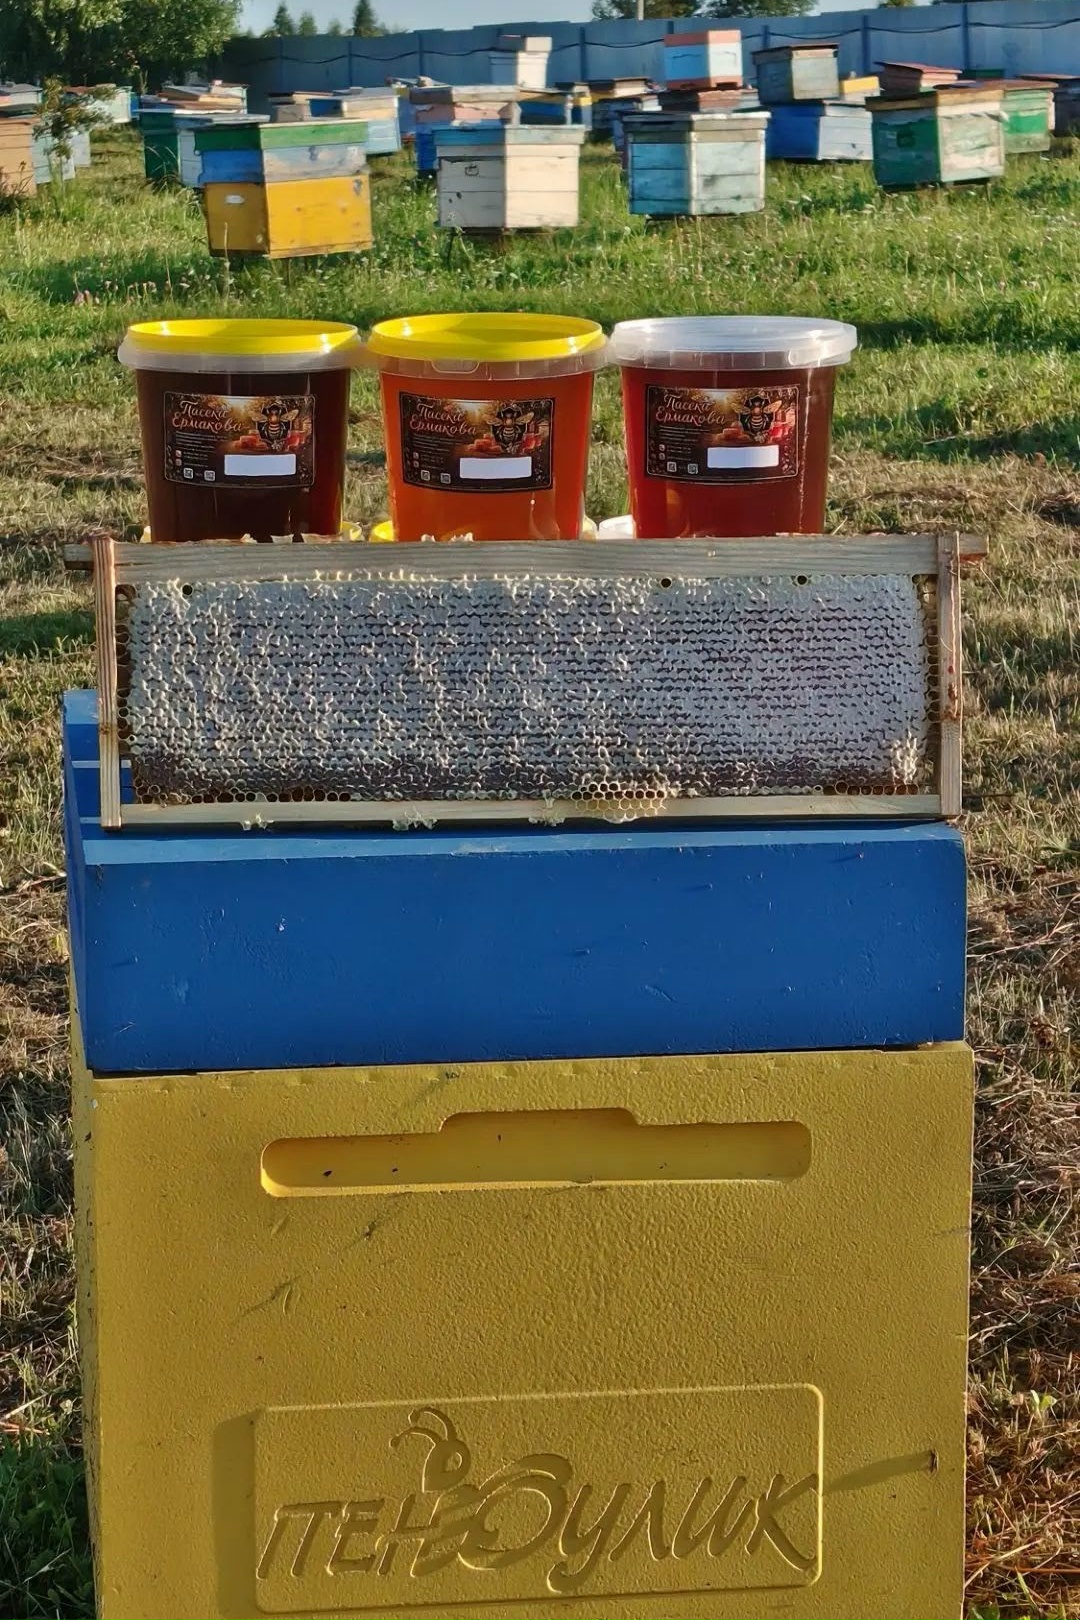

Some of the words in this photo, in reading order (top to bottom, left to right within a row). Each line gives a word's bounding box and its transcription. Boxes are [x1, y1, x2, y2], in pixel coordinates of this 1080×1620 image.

[180, 400, 229, 420] Пасека
[417, 402, 465, 424] Пасека
[663, 393, 712, 413] Пасека
[172, 411, 242, 434] Ермакова
[409, 414, 478, 437] Ермакова
[655, 406, 727, 427] Ермакова
